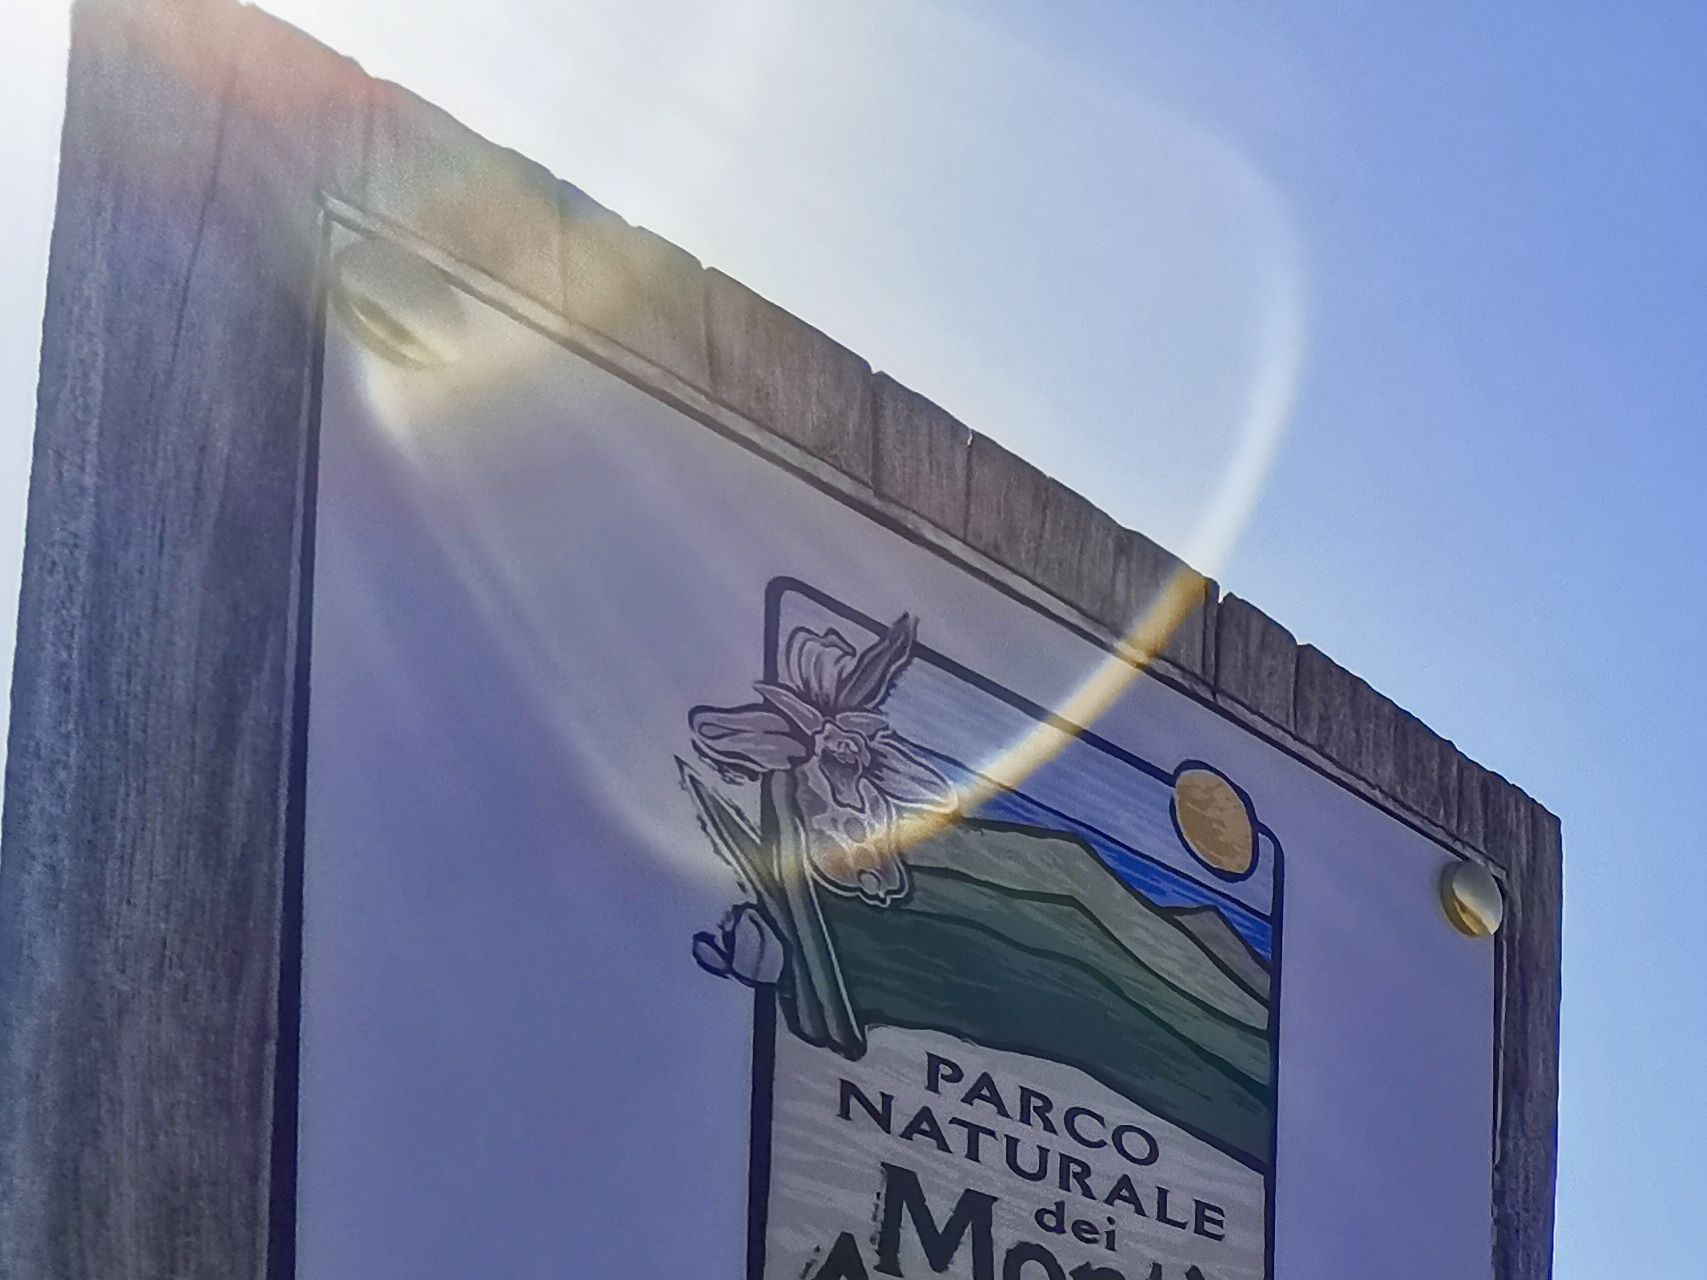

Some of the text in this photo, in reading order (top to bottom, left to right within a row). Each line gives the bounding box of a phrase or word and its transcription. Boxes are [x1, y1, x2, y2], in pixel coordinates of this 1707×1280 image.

[836, 1079, 1227, 1242] NATURALE
[924, 1052, 1160, 1168] PARCO
[1034, 1199, 1118, 1252] dei
